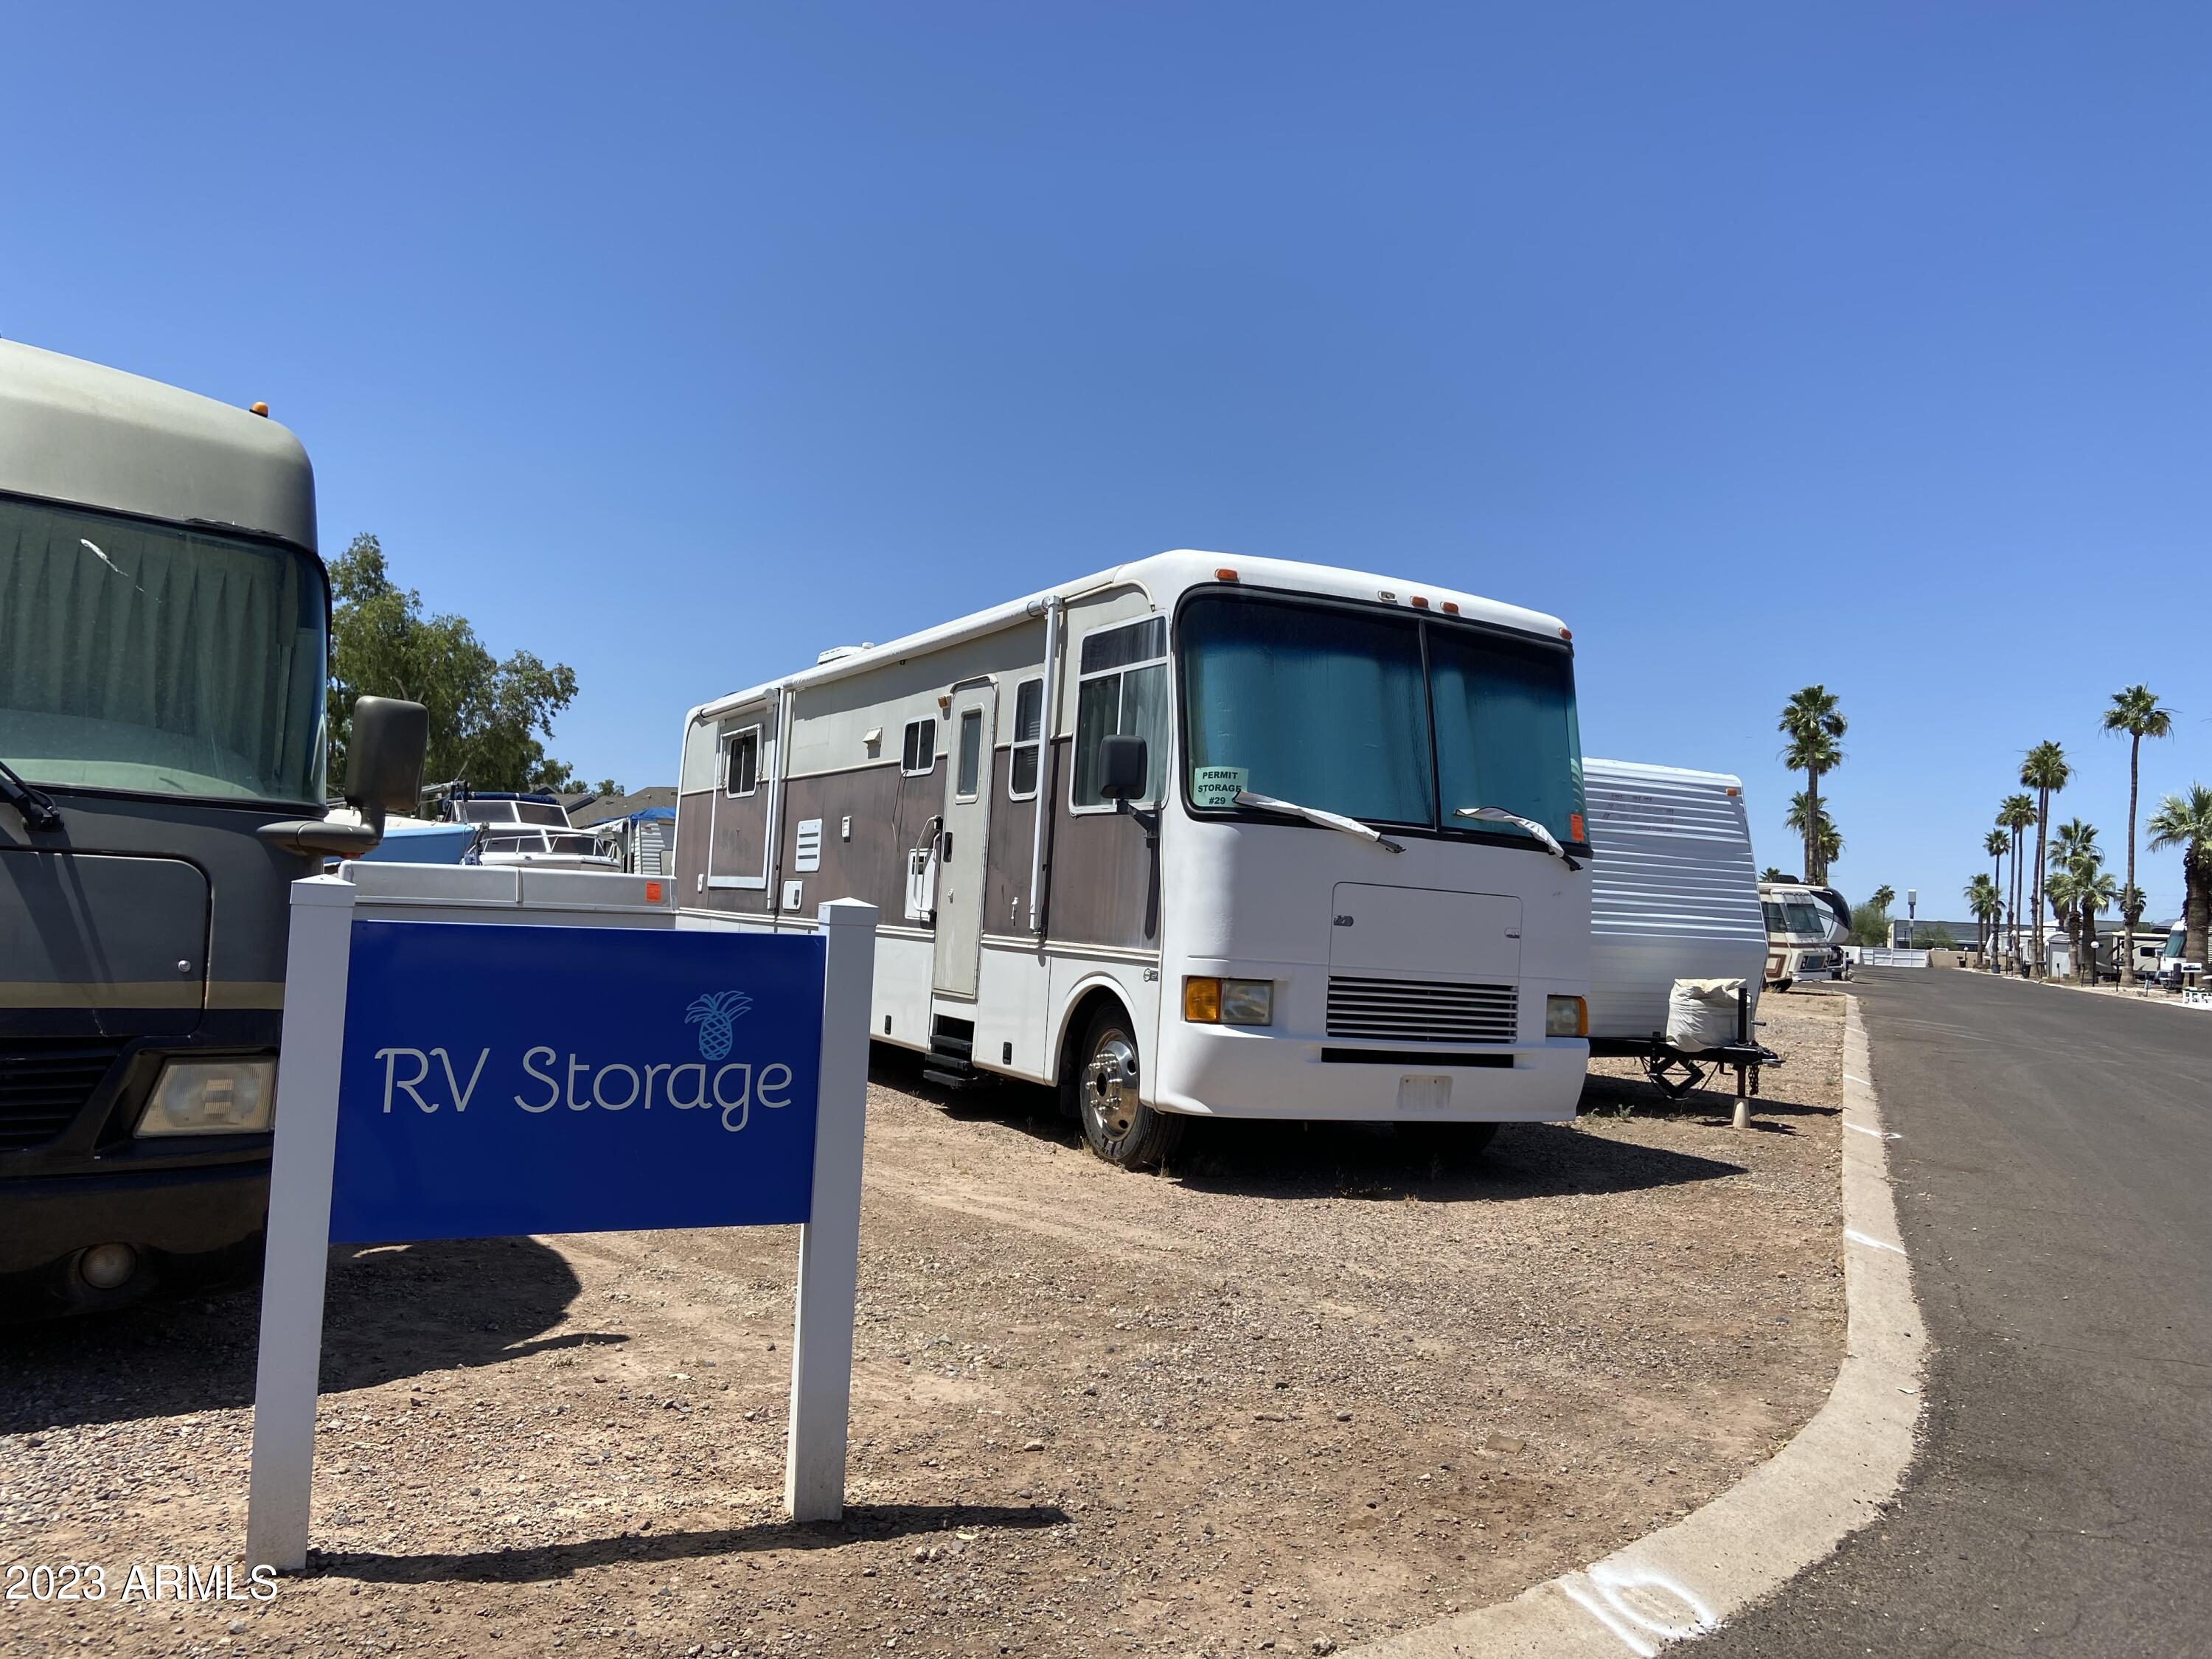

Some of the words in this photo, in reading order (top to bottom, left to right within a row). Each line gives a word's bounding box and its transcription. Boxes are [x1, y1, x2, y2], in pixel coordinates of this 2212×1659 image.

[1203, 771, 1238, 779] PERMIT
[1197, 784, 1242, 793] STORAGE
[1208, 796, 1226, 804] #29
[375, 1048, 490, 1113] RV
[514, 1046, 793, 1132] Storage
